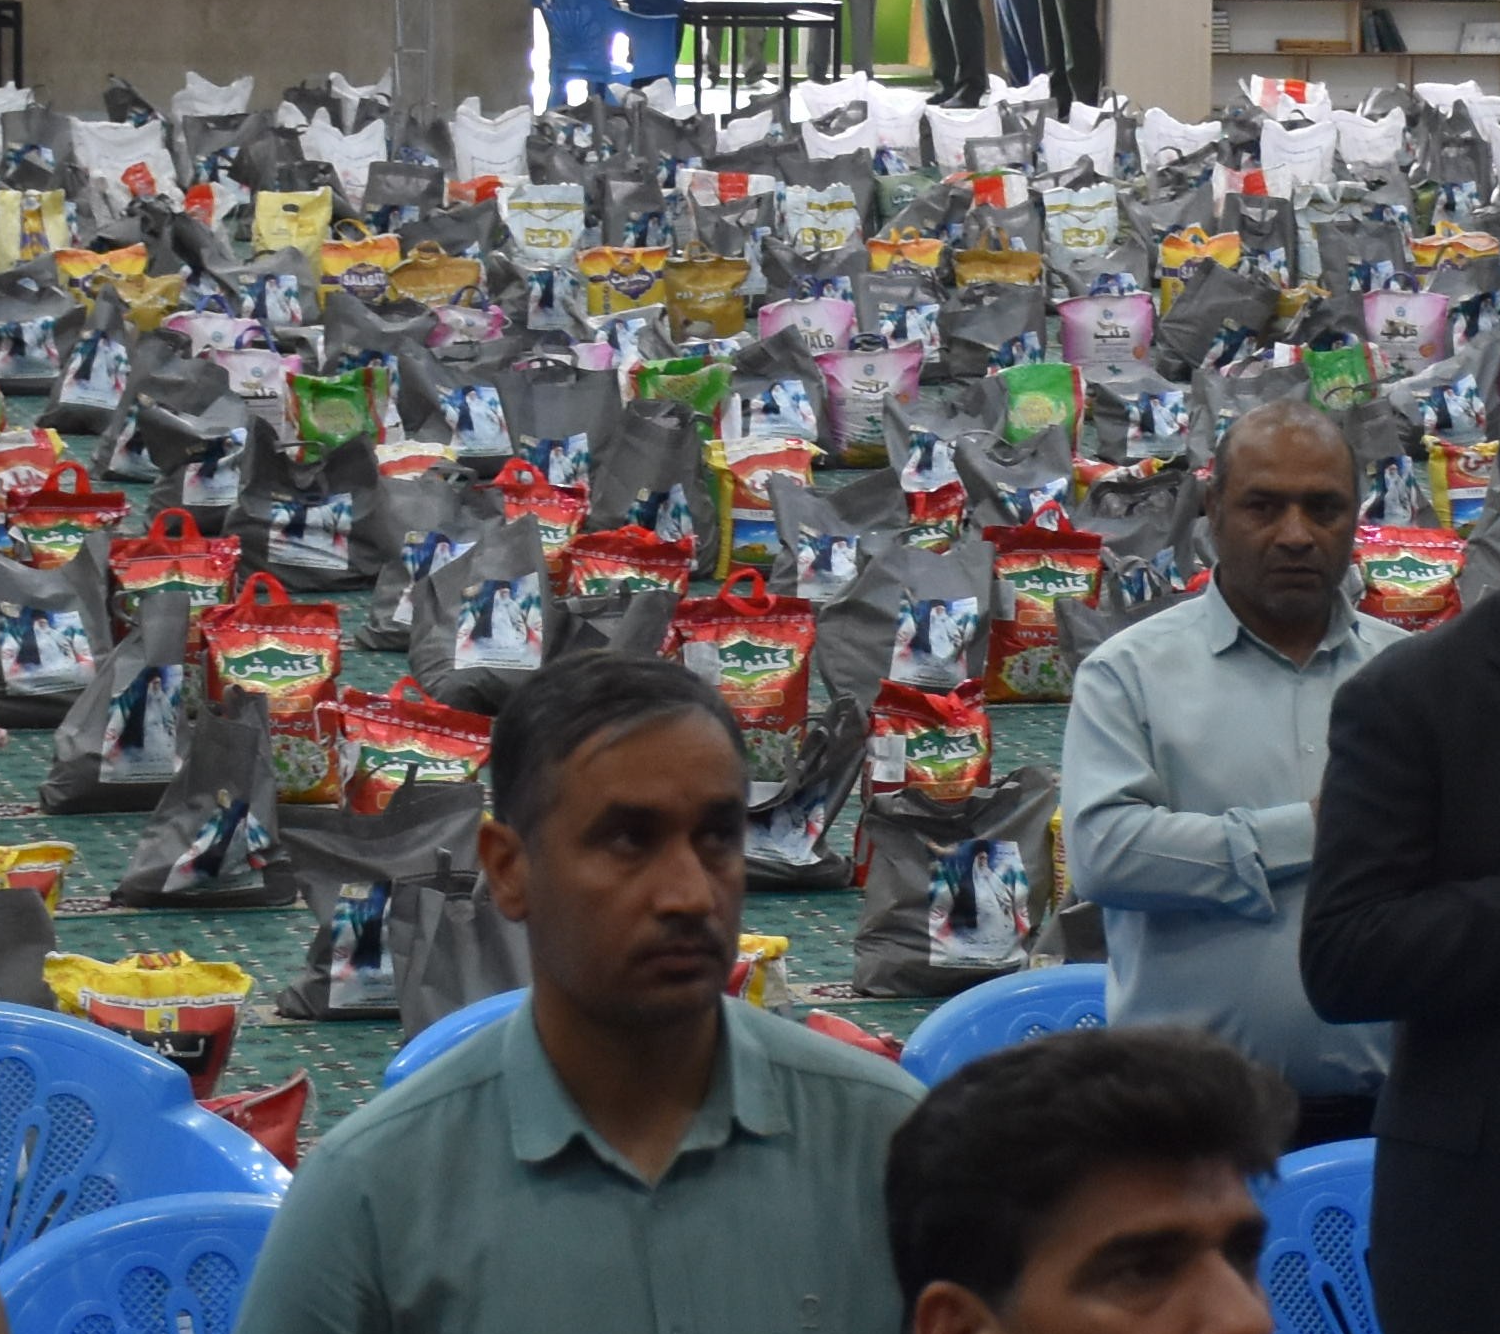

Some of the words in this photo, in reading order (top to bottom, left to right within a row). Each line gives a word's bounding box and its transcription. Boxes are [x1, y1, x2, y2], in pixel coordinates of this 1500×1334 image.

[1094, 327, 1132, 341] قلب
[1380, 323, 1418, 339] قلب
[229, 656, 321, 682] گلنوش
